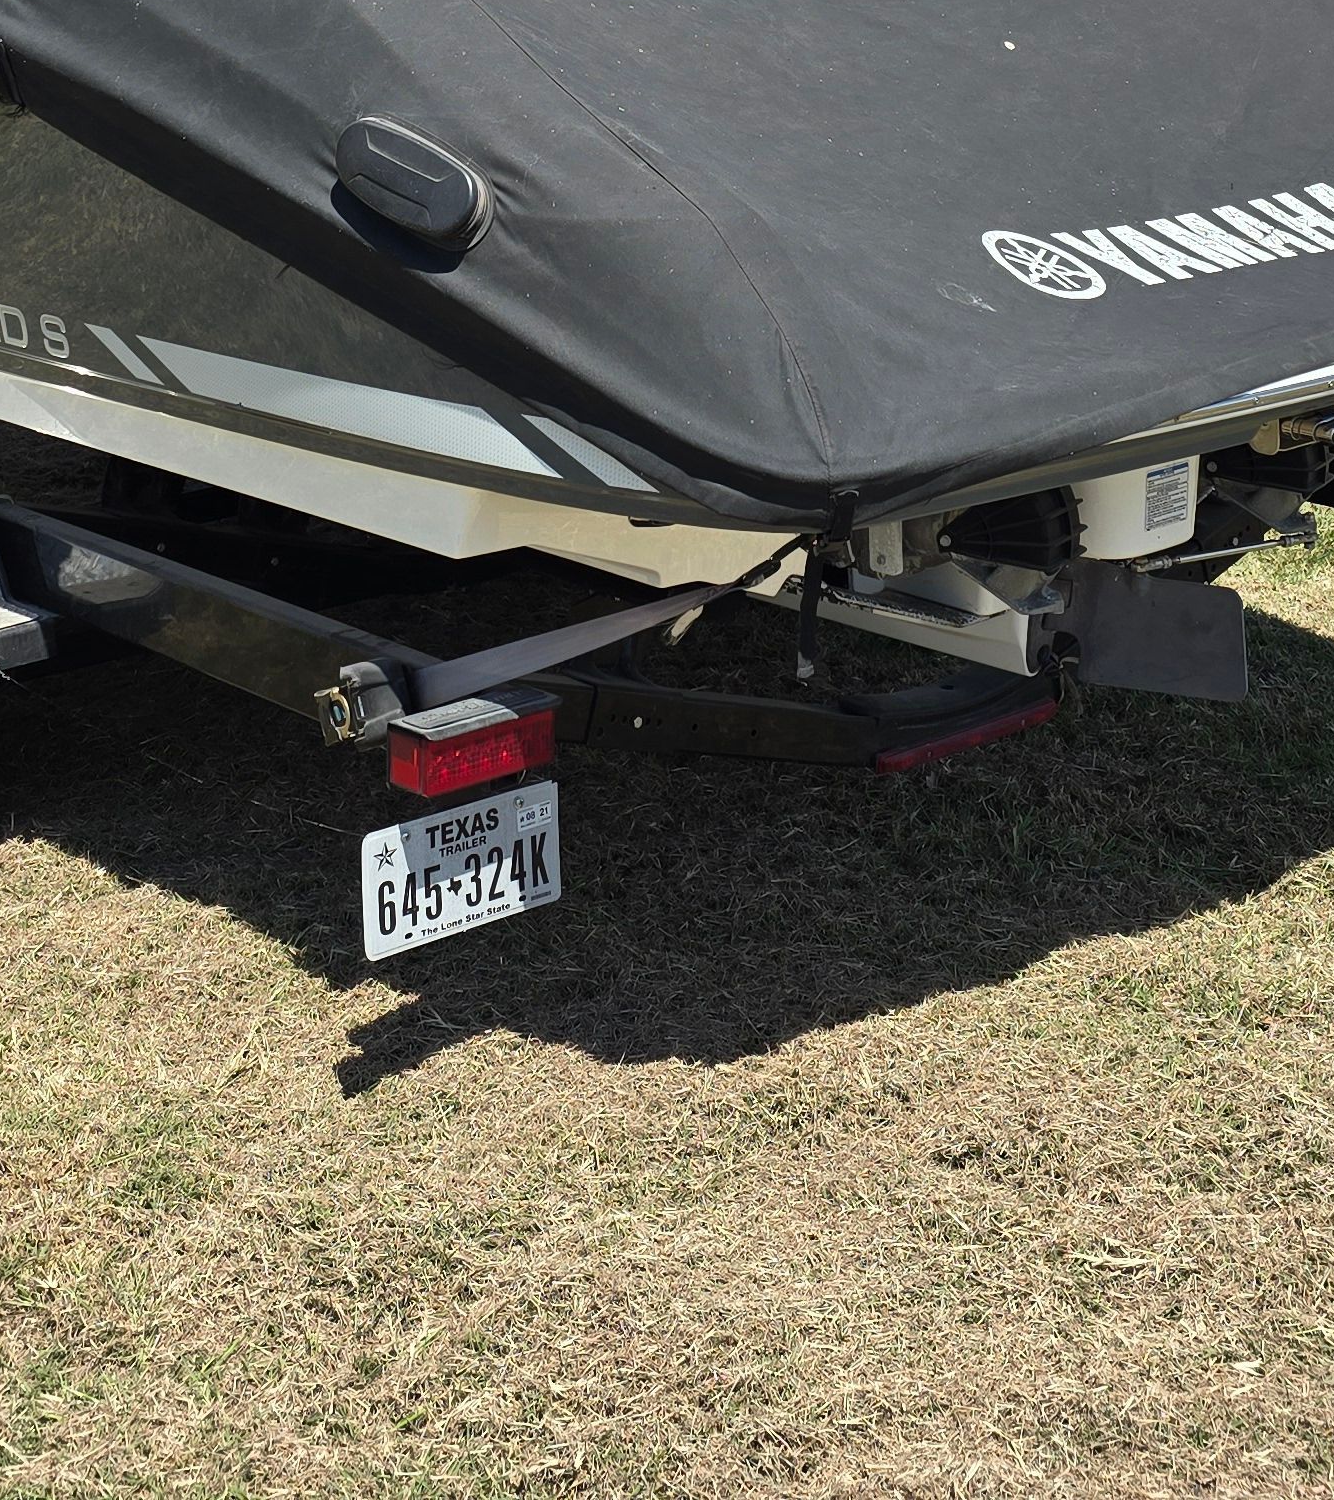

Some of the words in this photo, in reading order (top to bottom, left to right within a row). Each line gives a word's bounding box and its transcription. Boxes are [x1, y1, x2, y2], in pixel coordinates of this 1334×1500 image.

[39, 313, 70, 359] S
[425, 808, 499, 849] TEXAS
[439, 835, 487, 858] TRAILER
[420, 926, 439, 937] The
[441, 918, 463, 931] Lone
[465, 911, 485, 923] Star
[486, 903, 511, 916] State
